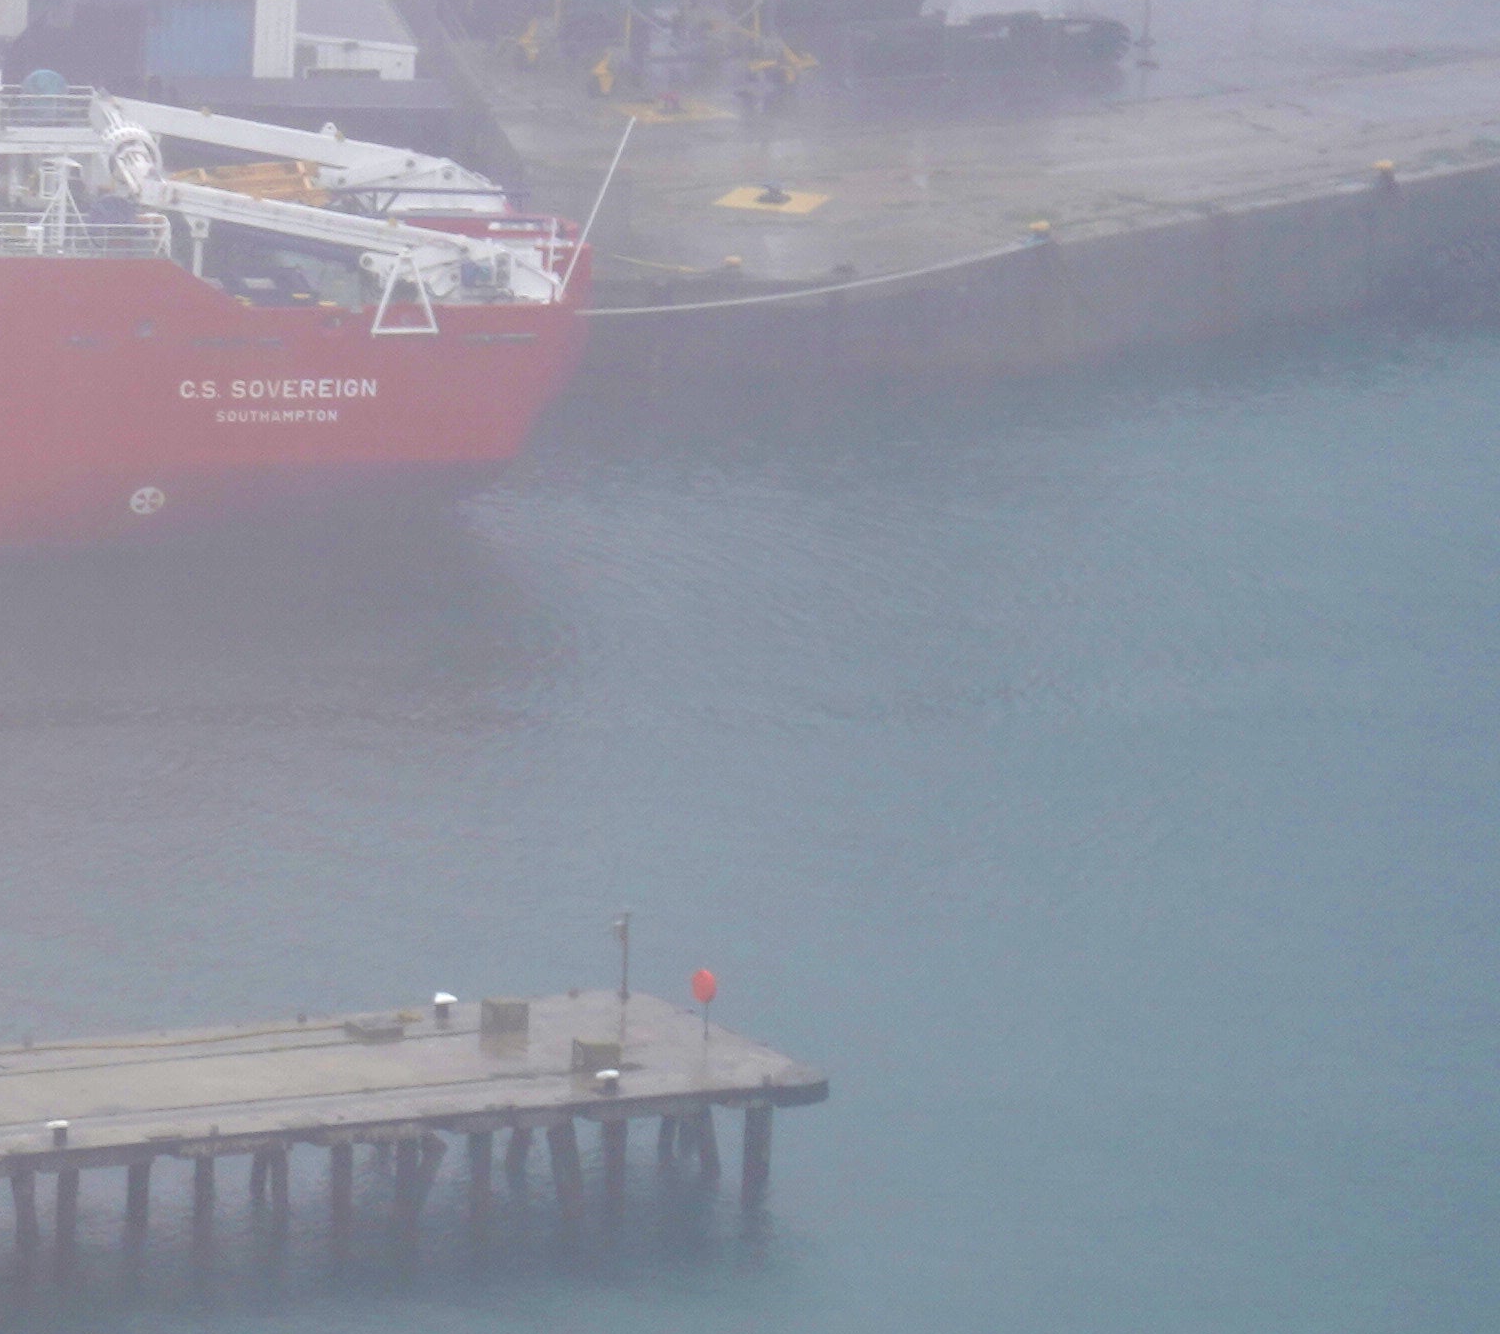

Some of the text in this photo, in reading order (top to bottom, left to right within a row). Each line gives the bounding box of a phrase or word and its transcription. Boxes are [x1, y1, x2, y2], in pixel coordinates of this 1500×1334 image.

[178, 378, 378, 399] C.S. SOVEREIGN
[215, 408, 339, 424] SOUTHAMPTON
